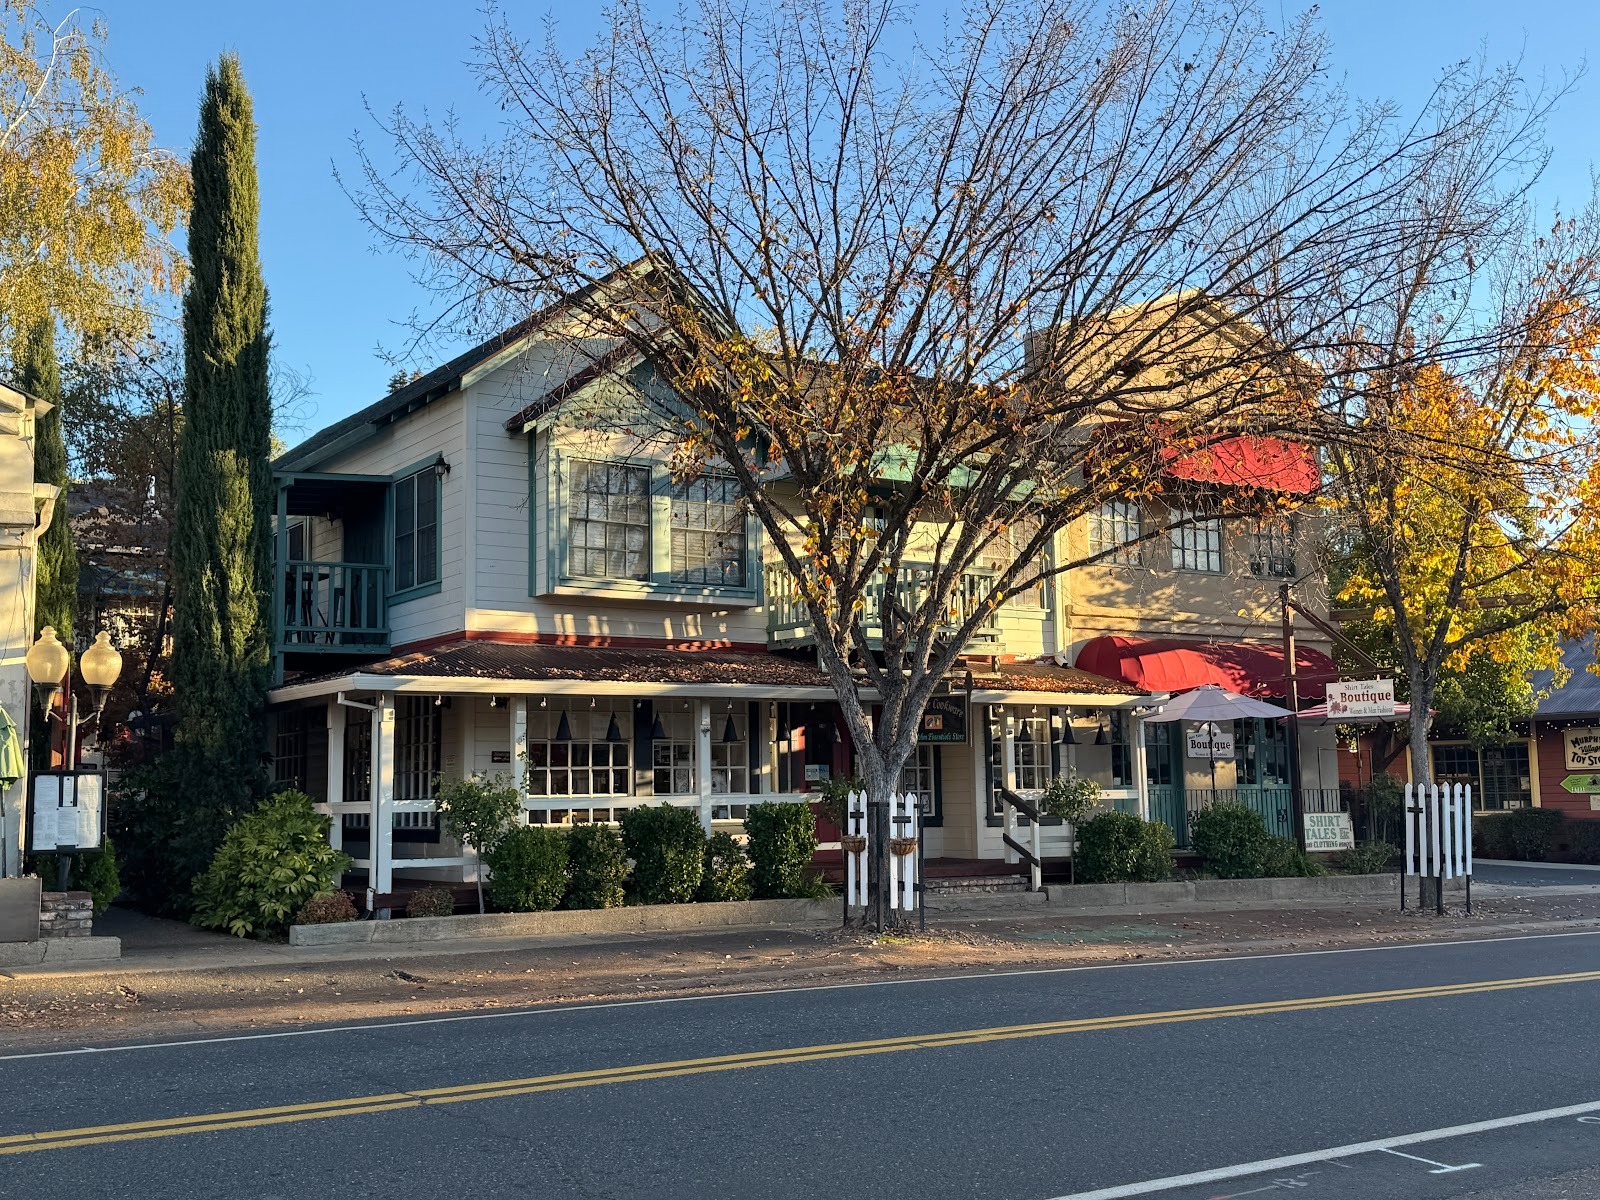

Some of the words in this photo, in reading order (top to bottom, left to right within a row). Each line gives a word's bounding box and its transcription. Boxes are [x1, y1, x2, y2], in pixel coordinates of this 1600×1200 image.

[1360, 682, 1374, 690] Tales
[1340, 690, 1391, 704] Boutique
[1570, 736, 1600, 748] MURPH
[1571, 751, 1587, 764] TOY
[1309, 815, 1341, 828] SHIRT
[1305, 827, 1337, 841] TALES
[1313, 840, 1339, 849] CLOTHING
